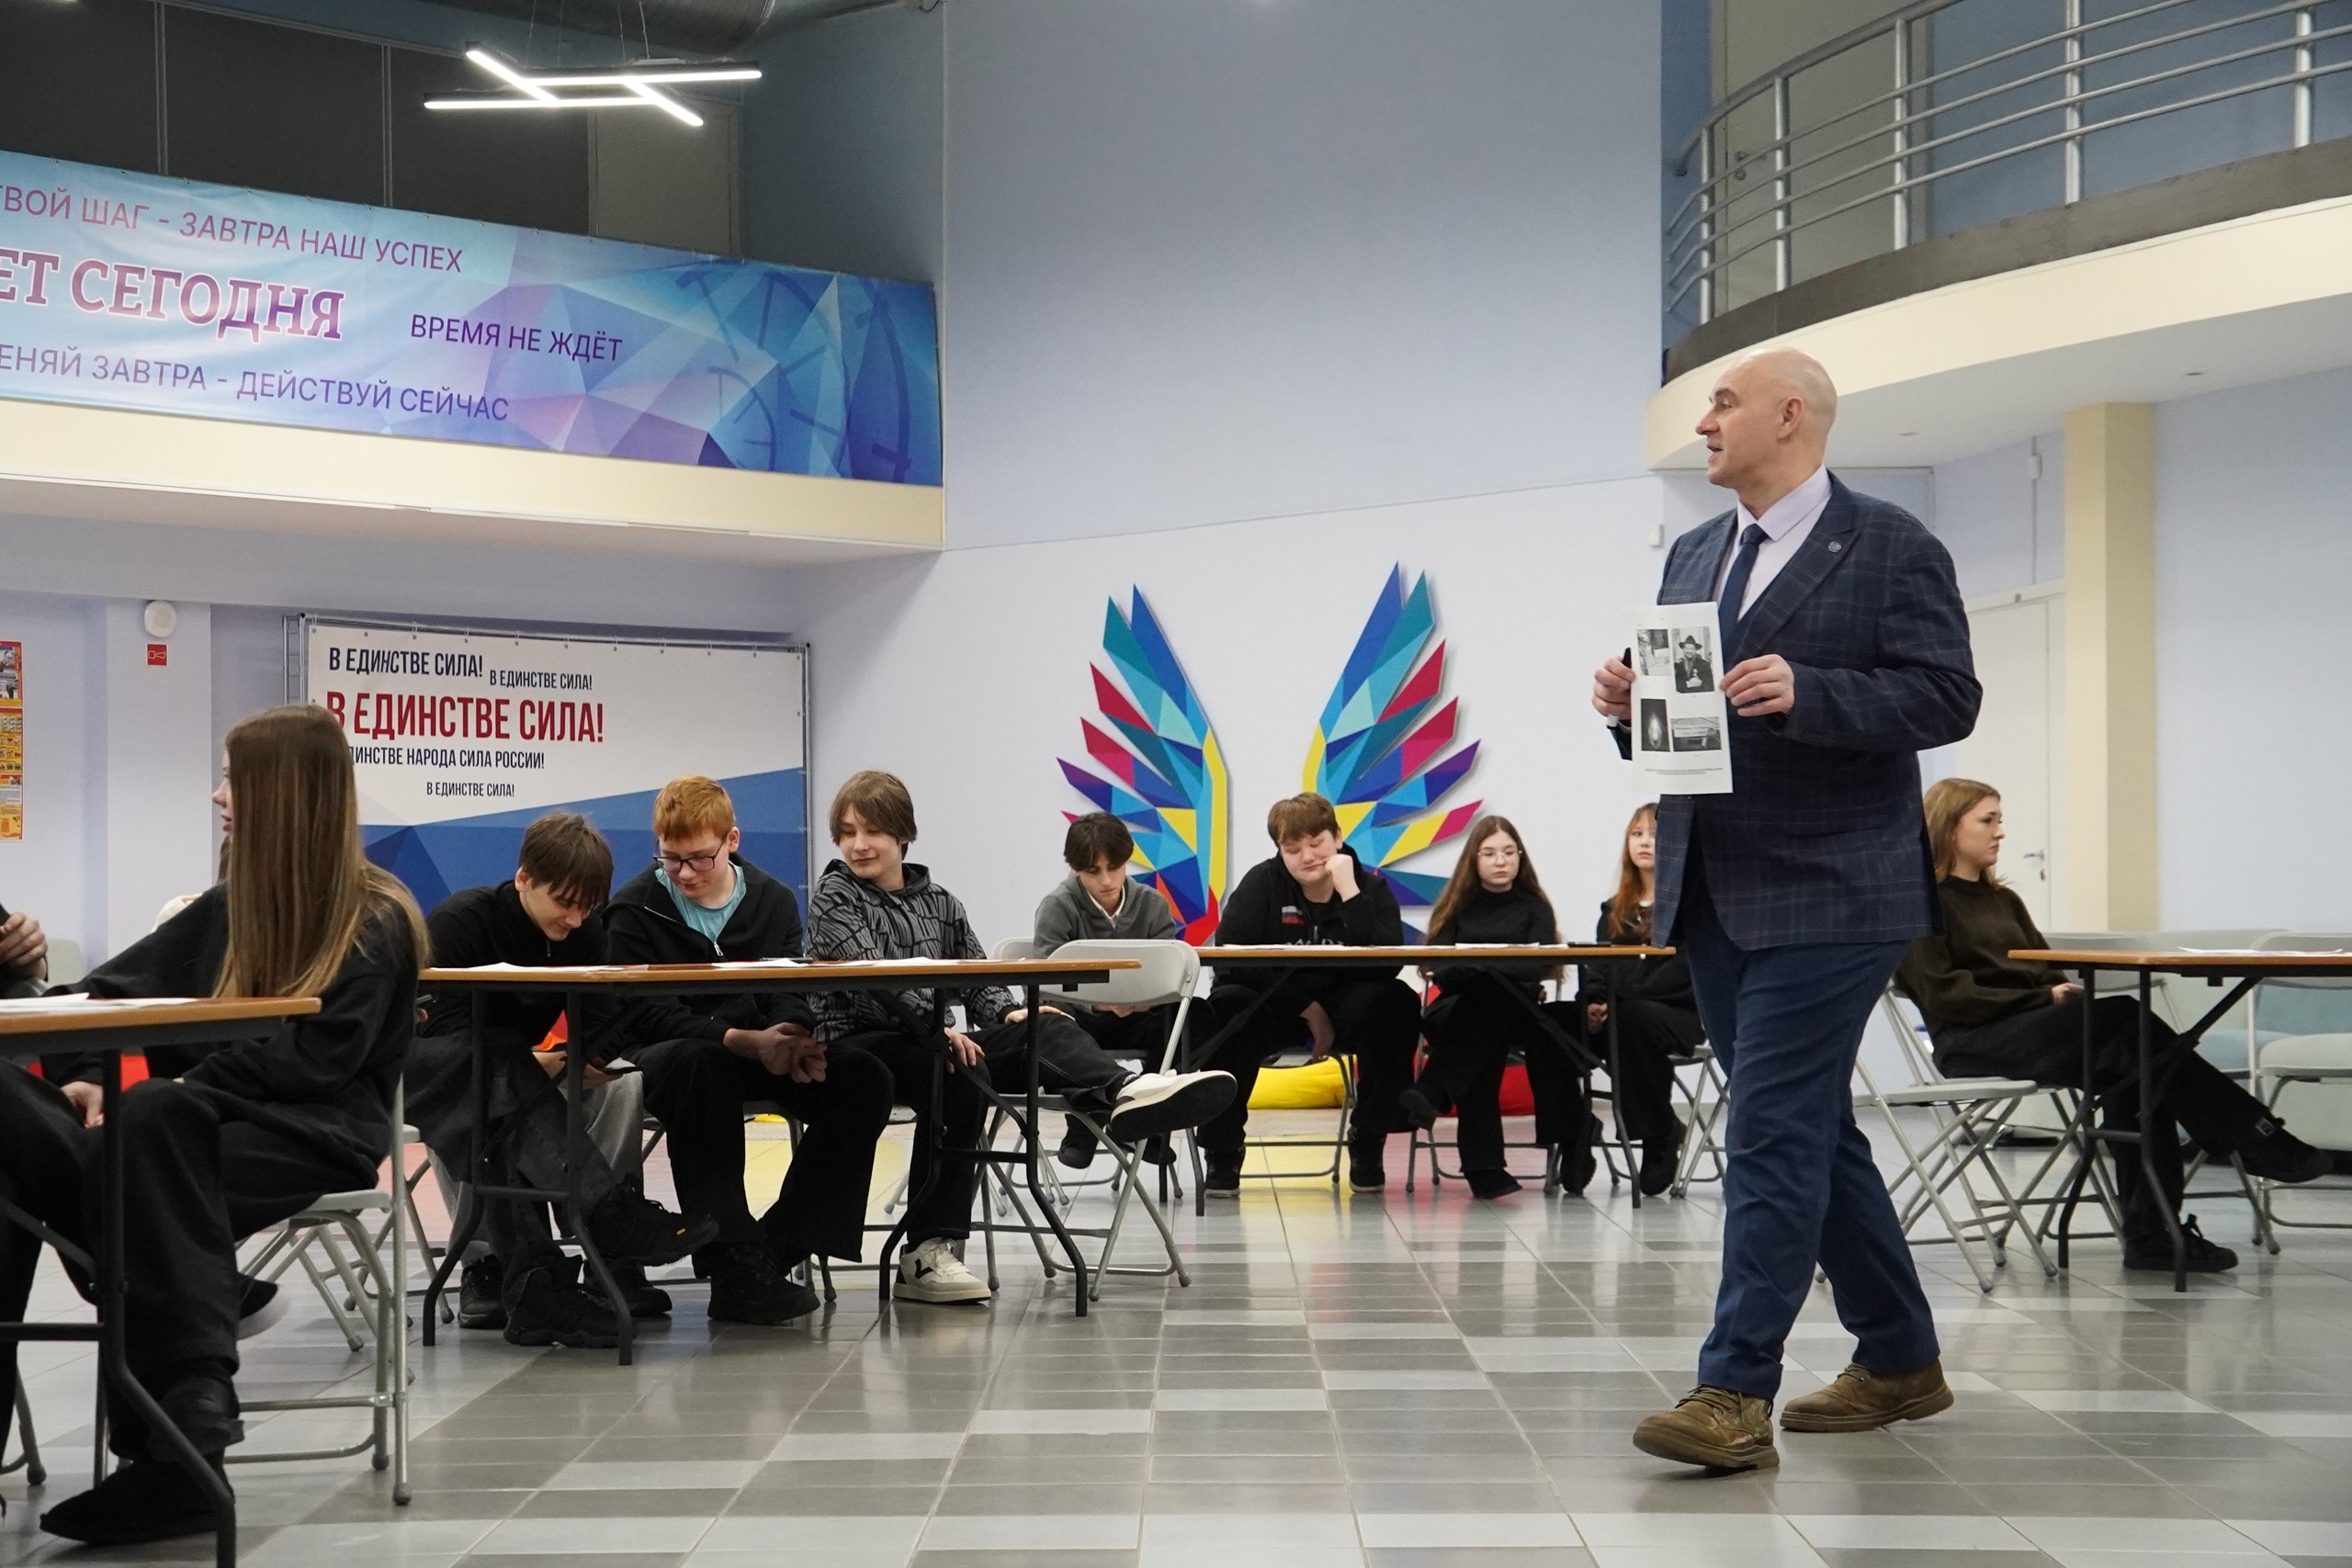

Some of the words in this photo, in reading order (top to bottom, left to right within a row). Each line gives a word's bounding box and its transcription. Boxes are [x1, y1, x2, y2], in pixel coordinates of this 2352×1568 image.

[0, 185, 71, 220] ВОЙ
[82, 197, 150, 230] ШАГ
[179, 211, 290, 251] ЗАВТРА
[300, 229, 366, 260] НАШ
[376, 238, 463, 273] УСПЕХ
[71, 258, 345, 343] СЕГОДНЯ
[411, 313, 501, 347] ВРЕМЯ
[508, 326, 542, 352] НЕ
[548, 331, 623, 363] ЖДЁТ
[92, 355, 207, 391] ЗАВТРА
[237, 369, 391, 410] ДЕЙСТВУЙ
[400, 386, 509, 421] СЕЙЧАС
[329, 647, 341, 671] В
[345, 648, 430, 675] ЕДИНСТВЕ
[435, 652, 483, 678] СИЛА!
[490, 670, 497, 686] В
[500, 670, 557, 689] ЕДИНСТВЕ
[560, 673, 593, 690] СИЛА!
[326, 691, 345, 731] В
[354, 693, 510, 740] ЕДИНСТВЕ
[519, 699, 604, 743] СИЛА!
[407, 748, 457, 768] НАРОДА
[459, 750, 492, 768] СИЛА
[495, 750, 545, 770] РОССИИ!
[426, 782, 433, 795] В
[435, 782, 484, 797] ЕДИНСТВЕ
[486, 784, 514, 797] СИЛА!
